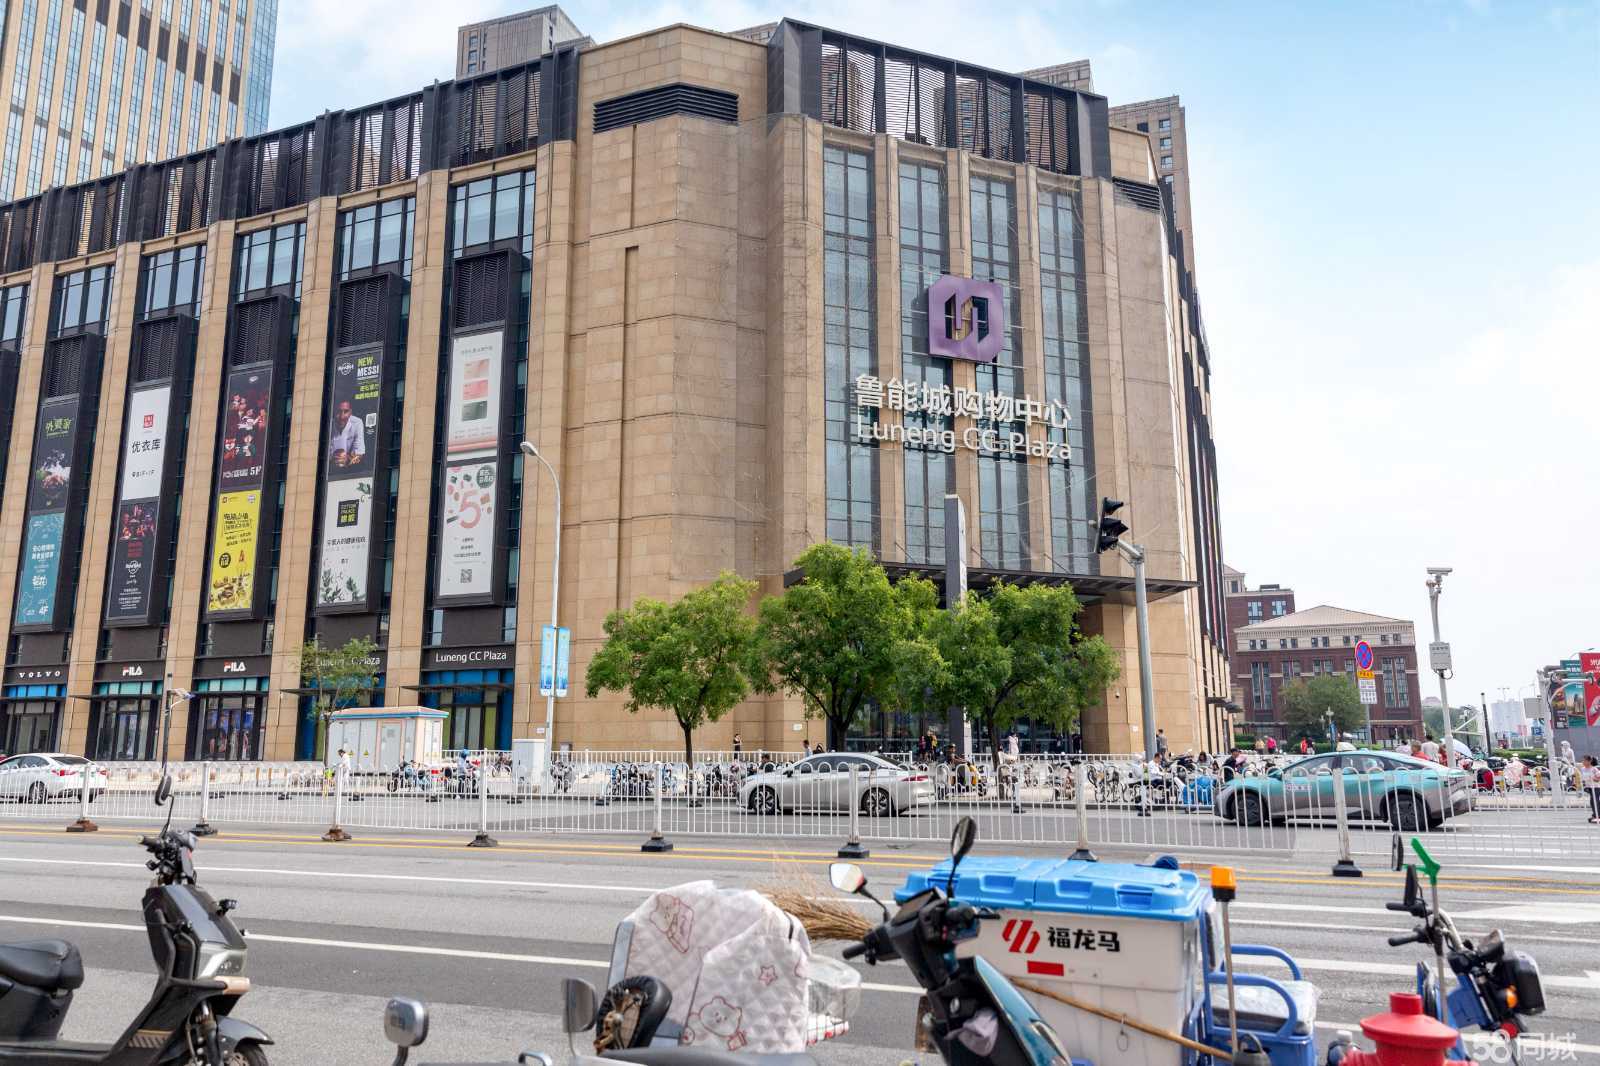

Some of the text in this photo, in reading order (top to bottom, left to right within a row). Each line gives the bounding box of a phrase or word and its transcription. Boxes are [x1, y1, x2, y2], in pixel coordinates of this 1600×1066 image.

[358, 356, 374, 367] NEW
[357, 365, 380, 377] MESSI
[855, 374, 1072, 429] 鲁能城购物中心
[858, 413, 1073, 460] Luneng CC Plaza
[132, 439, 161, 453] 优衣库
[436, 651, 507, 663] Luneng CC Plaza
[122, 666, 143, 676] FILA
[224, 661, 246, 672] FILA
[19, 670, 61, 678] VOLVO
[1047, 926, 1120, 952] 福龙马
